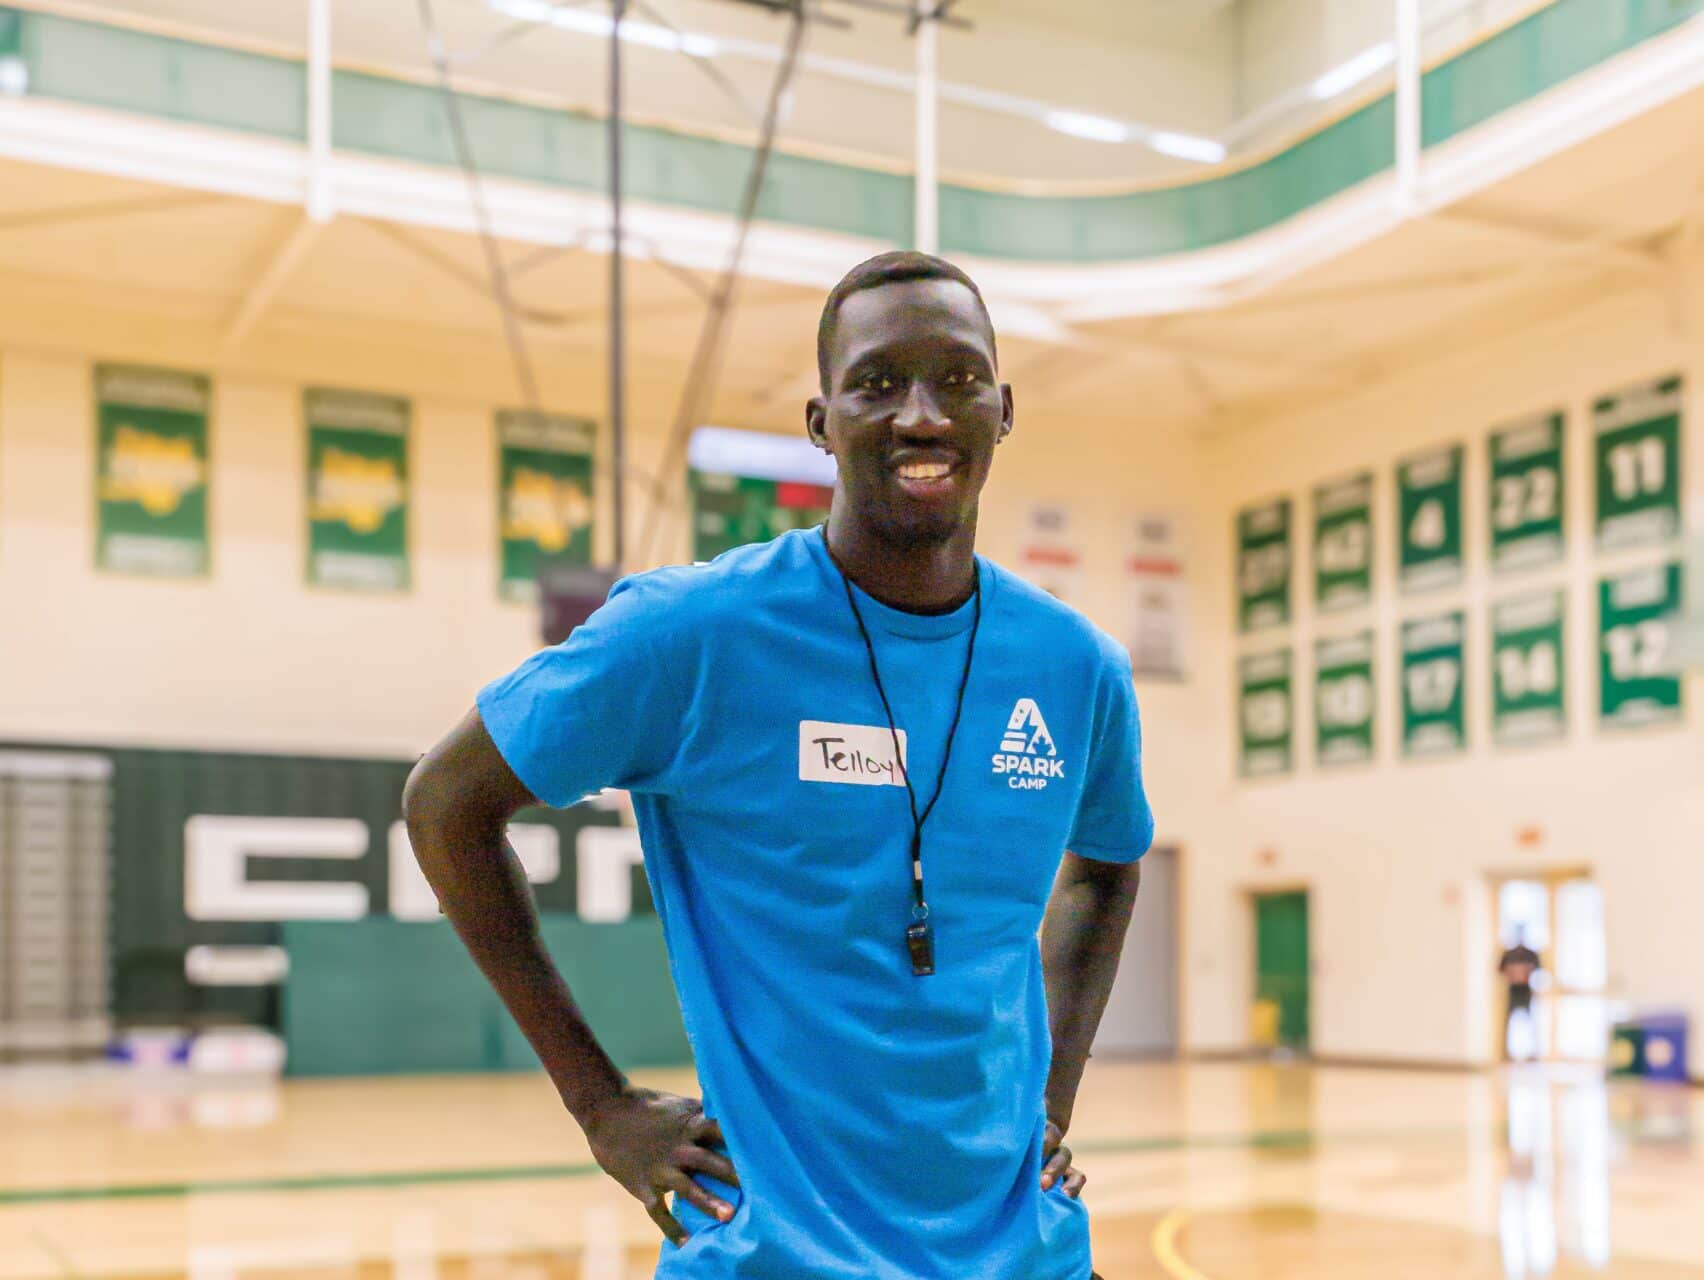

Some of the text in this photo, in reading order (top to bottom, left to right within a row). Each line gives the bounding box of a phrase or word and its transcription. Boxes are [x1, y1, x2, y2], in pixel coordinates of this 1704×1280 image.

[1607, 436, 1665, 501] 11
[1409, 498, 1446, 549] 4
[991, 753, 1065, 778] SPARK
[1008, 777, 1048, 790] CAMP
